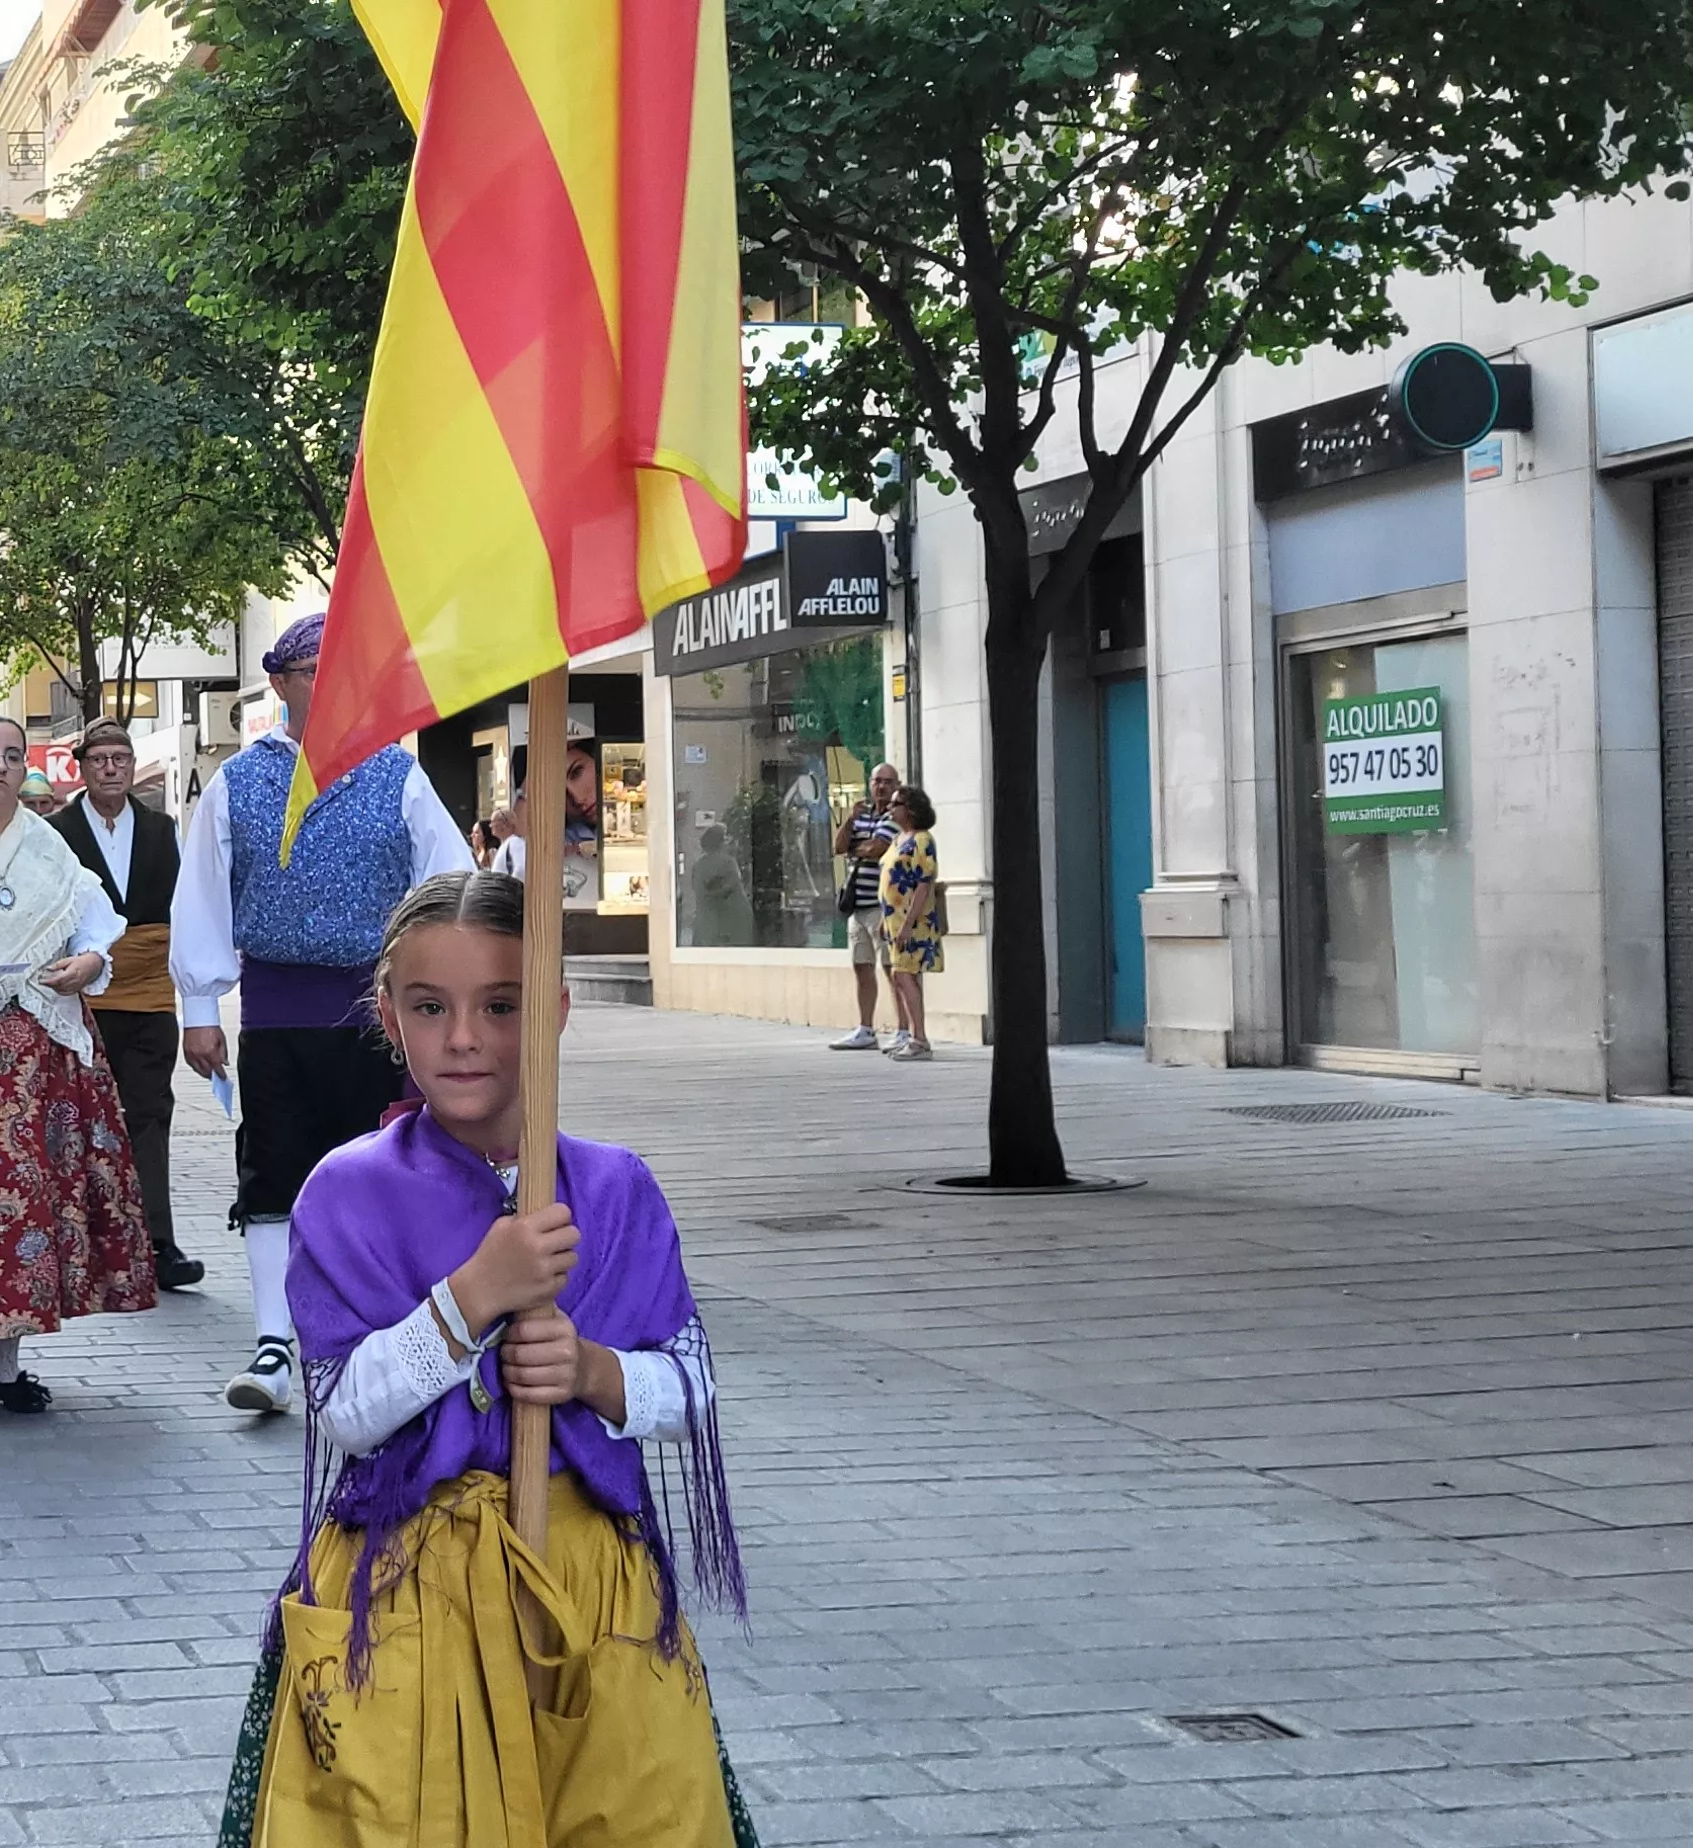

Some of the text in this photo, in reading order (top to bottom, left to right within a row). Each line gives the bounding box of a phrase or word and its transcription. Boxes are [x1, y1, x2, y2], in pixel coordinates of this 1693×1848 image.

[826, 577, 879, 596] ALAIN
[797, 596, 881, 616] AFFLELOU
[1327, 696, 1438, 738] ALQUILADO
[1329, 744, 1438, 785] 957 47 05 30
[1330, 804, 1440, 823] www.santiagocruz.es
